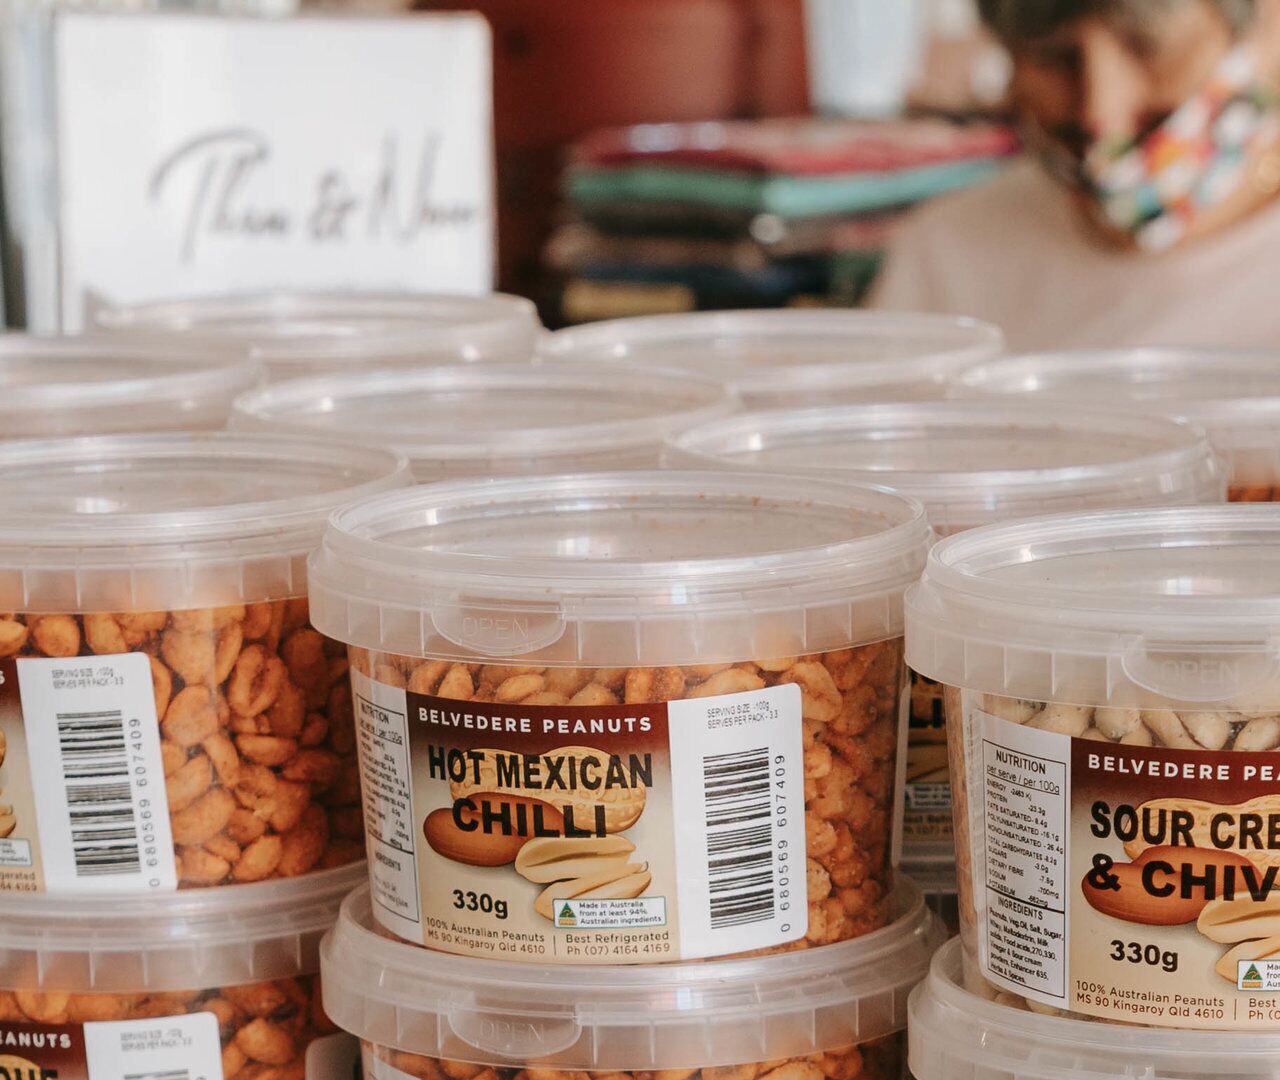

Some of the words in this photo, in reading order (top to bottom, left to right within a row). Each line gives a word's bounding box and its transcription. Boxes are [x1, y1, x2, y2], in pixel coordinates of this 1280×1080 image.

[419, 708, 531, 733] BELVEDERE
[542, 717, 651, 734] PEANUTS
[428, 745, 485, 782] HOT
[495, 752, 653, 789] MEXICAN
[996, 750, 1046, 774] NUTRITION
[1088, 754, 1229, 780] BELVEDERE
[987, 765, 997, 776] per
[999, 770, 1016, 782] serve
[1024, 777, 1036, 788] per
[1039, 781, 1060, 794] 100g
[452, 798, 606, 838] CHILLI
[1090, 800, 1194, 847] SOUR
[1088, 853, 1121, 891] &
[452, 890, 509, 919] 330g
[998, 897, 1043, 920] INGREDIENTS
[1110, 940, 1178, 972] 330g
[1076, 981, 1106, 995] 100%
[1110, 987, 1169, 1003] Australian
[1174, 995, 1224, 1007] Peanuts
[1076, 994, 1091, 1004] MS
[1095, 996, 1109, 1007] 90
[1113, 1000, 1164, 1016] Kingaroy
[1168, 1003, 1190, 1017] Qld
[1194, 1007, 1224, 1019] 4610
[1249, 998, 1277, 1008] Best
[1249, 1010, 1264, 1020] Ph
